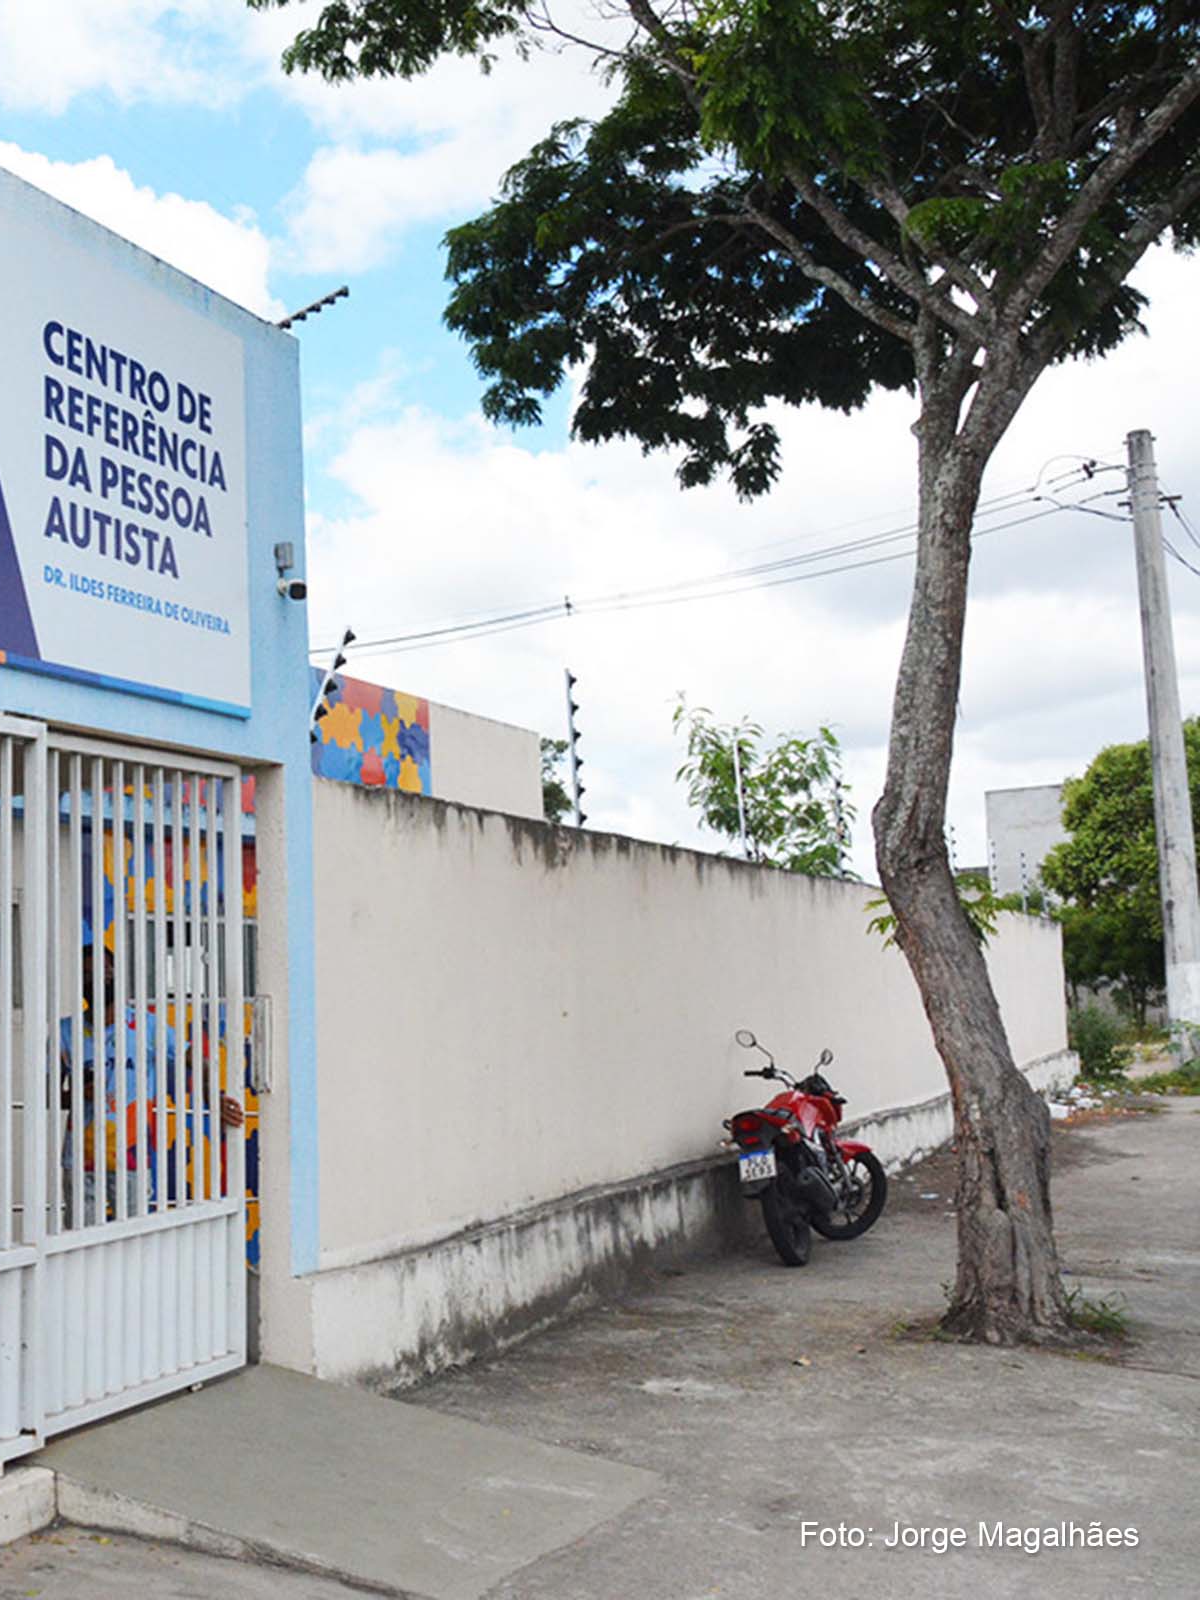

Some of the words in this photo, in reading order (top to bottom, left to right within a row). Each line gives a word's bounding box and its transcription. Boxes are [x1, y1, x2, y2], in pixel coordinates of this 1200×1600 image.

[43, 320, 171, 413] CENTRO
[177, 381, 212, 435] DE
[44, 375, 227, 492] REFERÊNCIA
[43, 495, 179, 579] AUTISTA
[44, 434, 92, 493] DA
[100, 456, 212, 538] PESSOA
[43, 565, 67, 588] DR.
[69, 573, 105, 599] ILDES
[106, 584, 164, 616] FERREIRA
[164, 601, 180, 621] DE
[180, 607, 231, 635] OLIVEIRA
